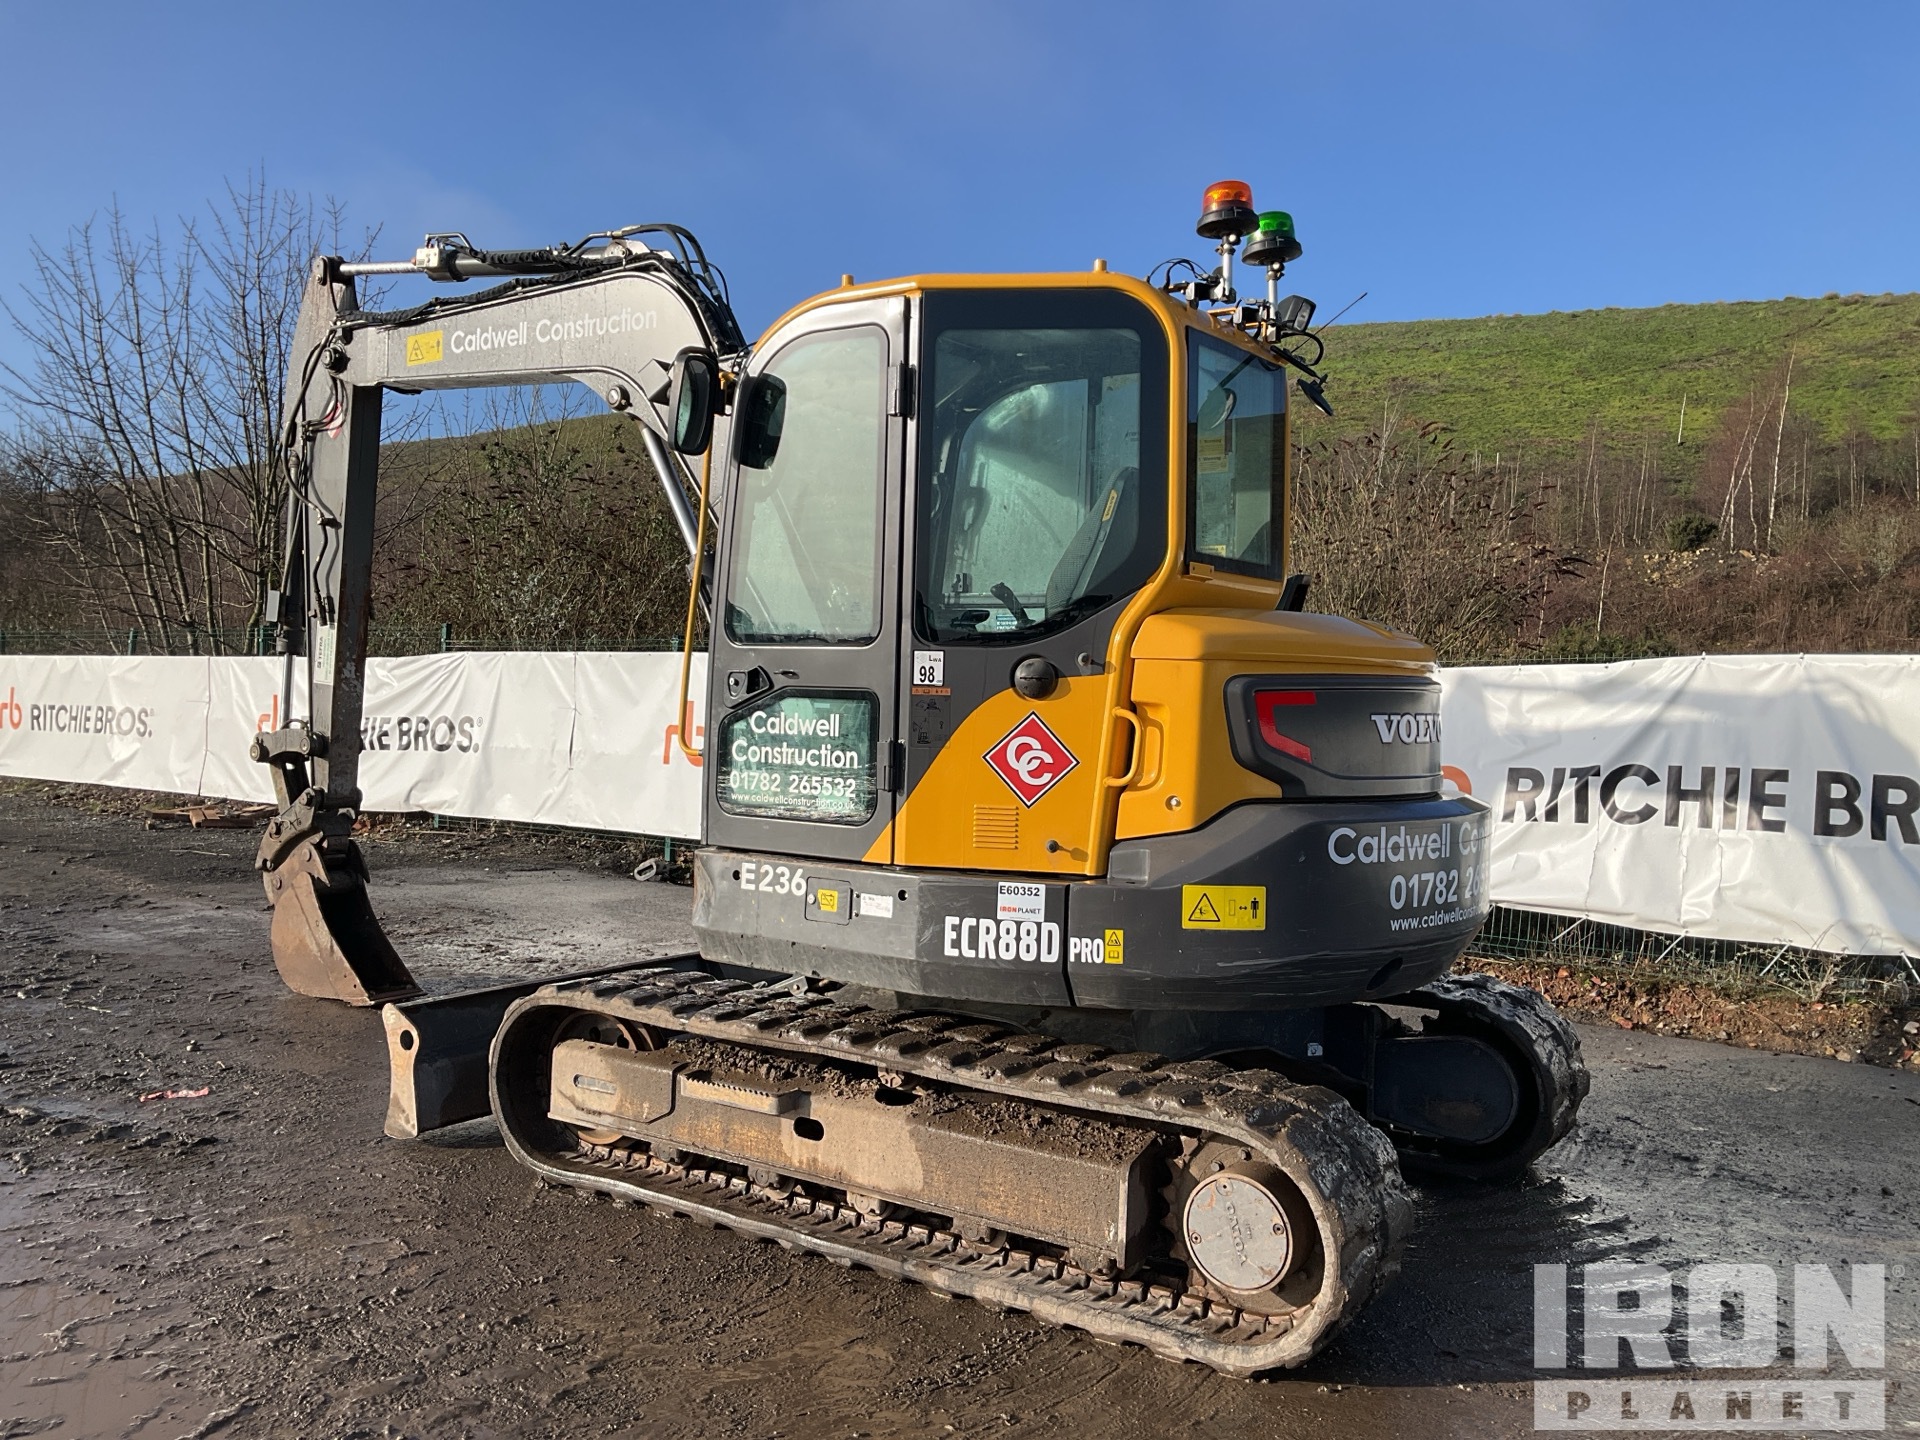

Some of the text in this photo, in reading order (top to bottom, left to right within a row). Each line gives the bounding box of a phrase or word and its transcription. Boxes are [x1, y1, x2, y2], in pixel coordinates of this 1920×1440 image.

[450, 308, 657, 354] Caldwell Construction
[919, 665, 935, 684] 98
[30, 704, 92, 734] RITCHIE
[93, 705, 153, 739] BROS.
[396, 715, 480, 754] BROS.
[750, 711, 840, 738] Caldwell
[731, 739, 859, 769] Construction
[729, 770, 856, 798] 01782 265532
[1501, 764, 1790, 833] RITCHIE
[1328, 823, 1450, 865] Caldwell
[740, 862, 807, 896] E236
[999, 885, 1040, 897] E60352
[1389, 869, 1459, 910] 01782
[1017, 907, 1041, 915] PLANET
[944, 915, 1104, 964] ECR88D PRO
